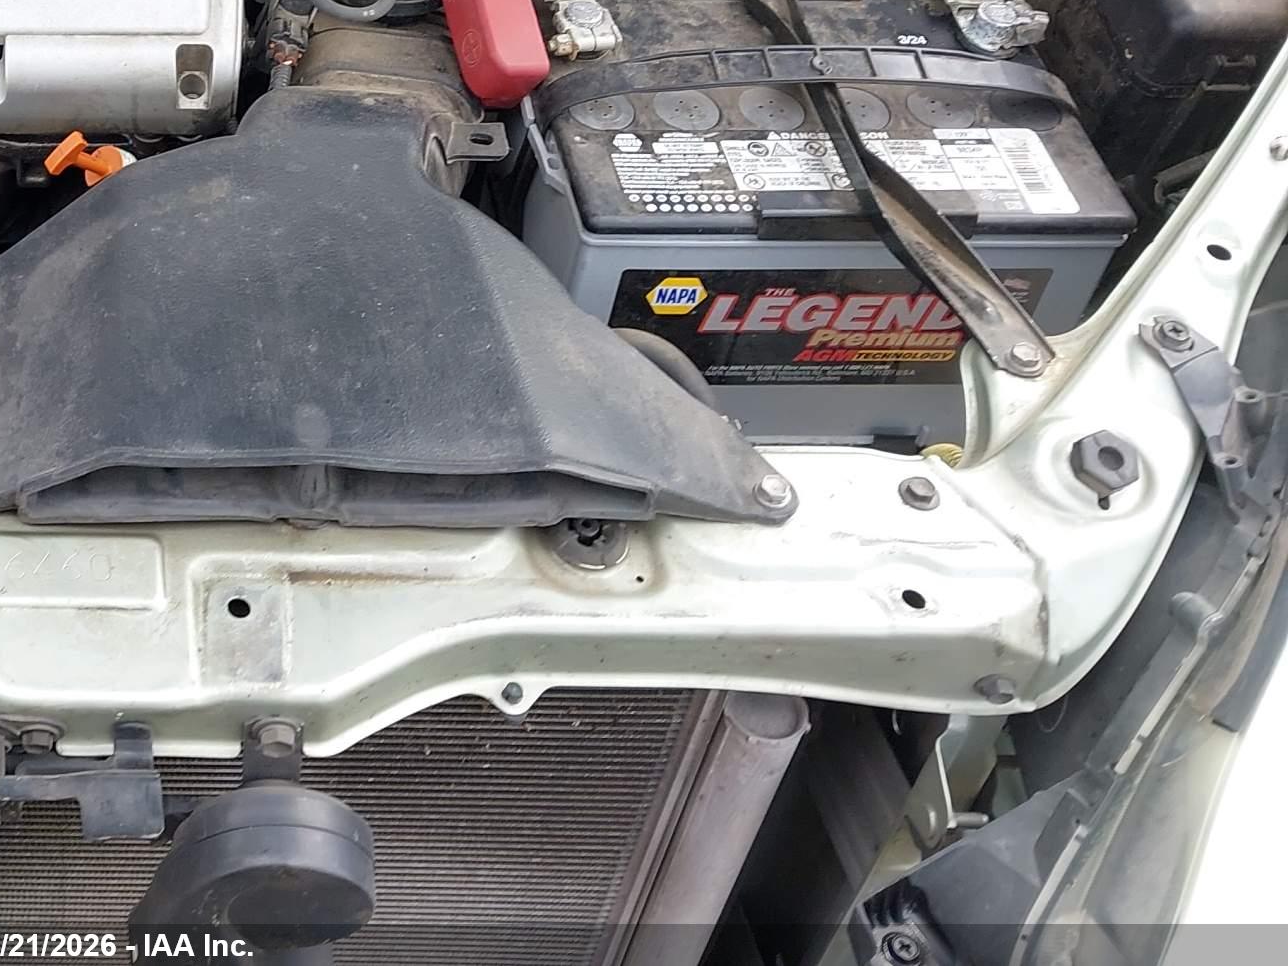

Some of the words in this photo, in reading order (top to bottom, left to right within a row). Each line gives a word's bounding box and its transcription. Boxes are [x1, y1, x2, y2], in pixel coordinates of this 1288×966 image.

[655, 288, 698, 304] NAPA
[764, 288, 796, 296] THE
[808, 328, 962, 348] Premium
[793, 350, 854, 362] AGM
[855, 351, 955, 361] TECHNOLOGY
